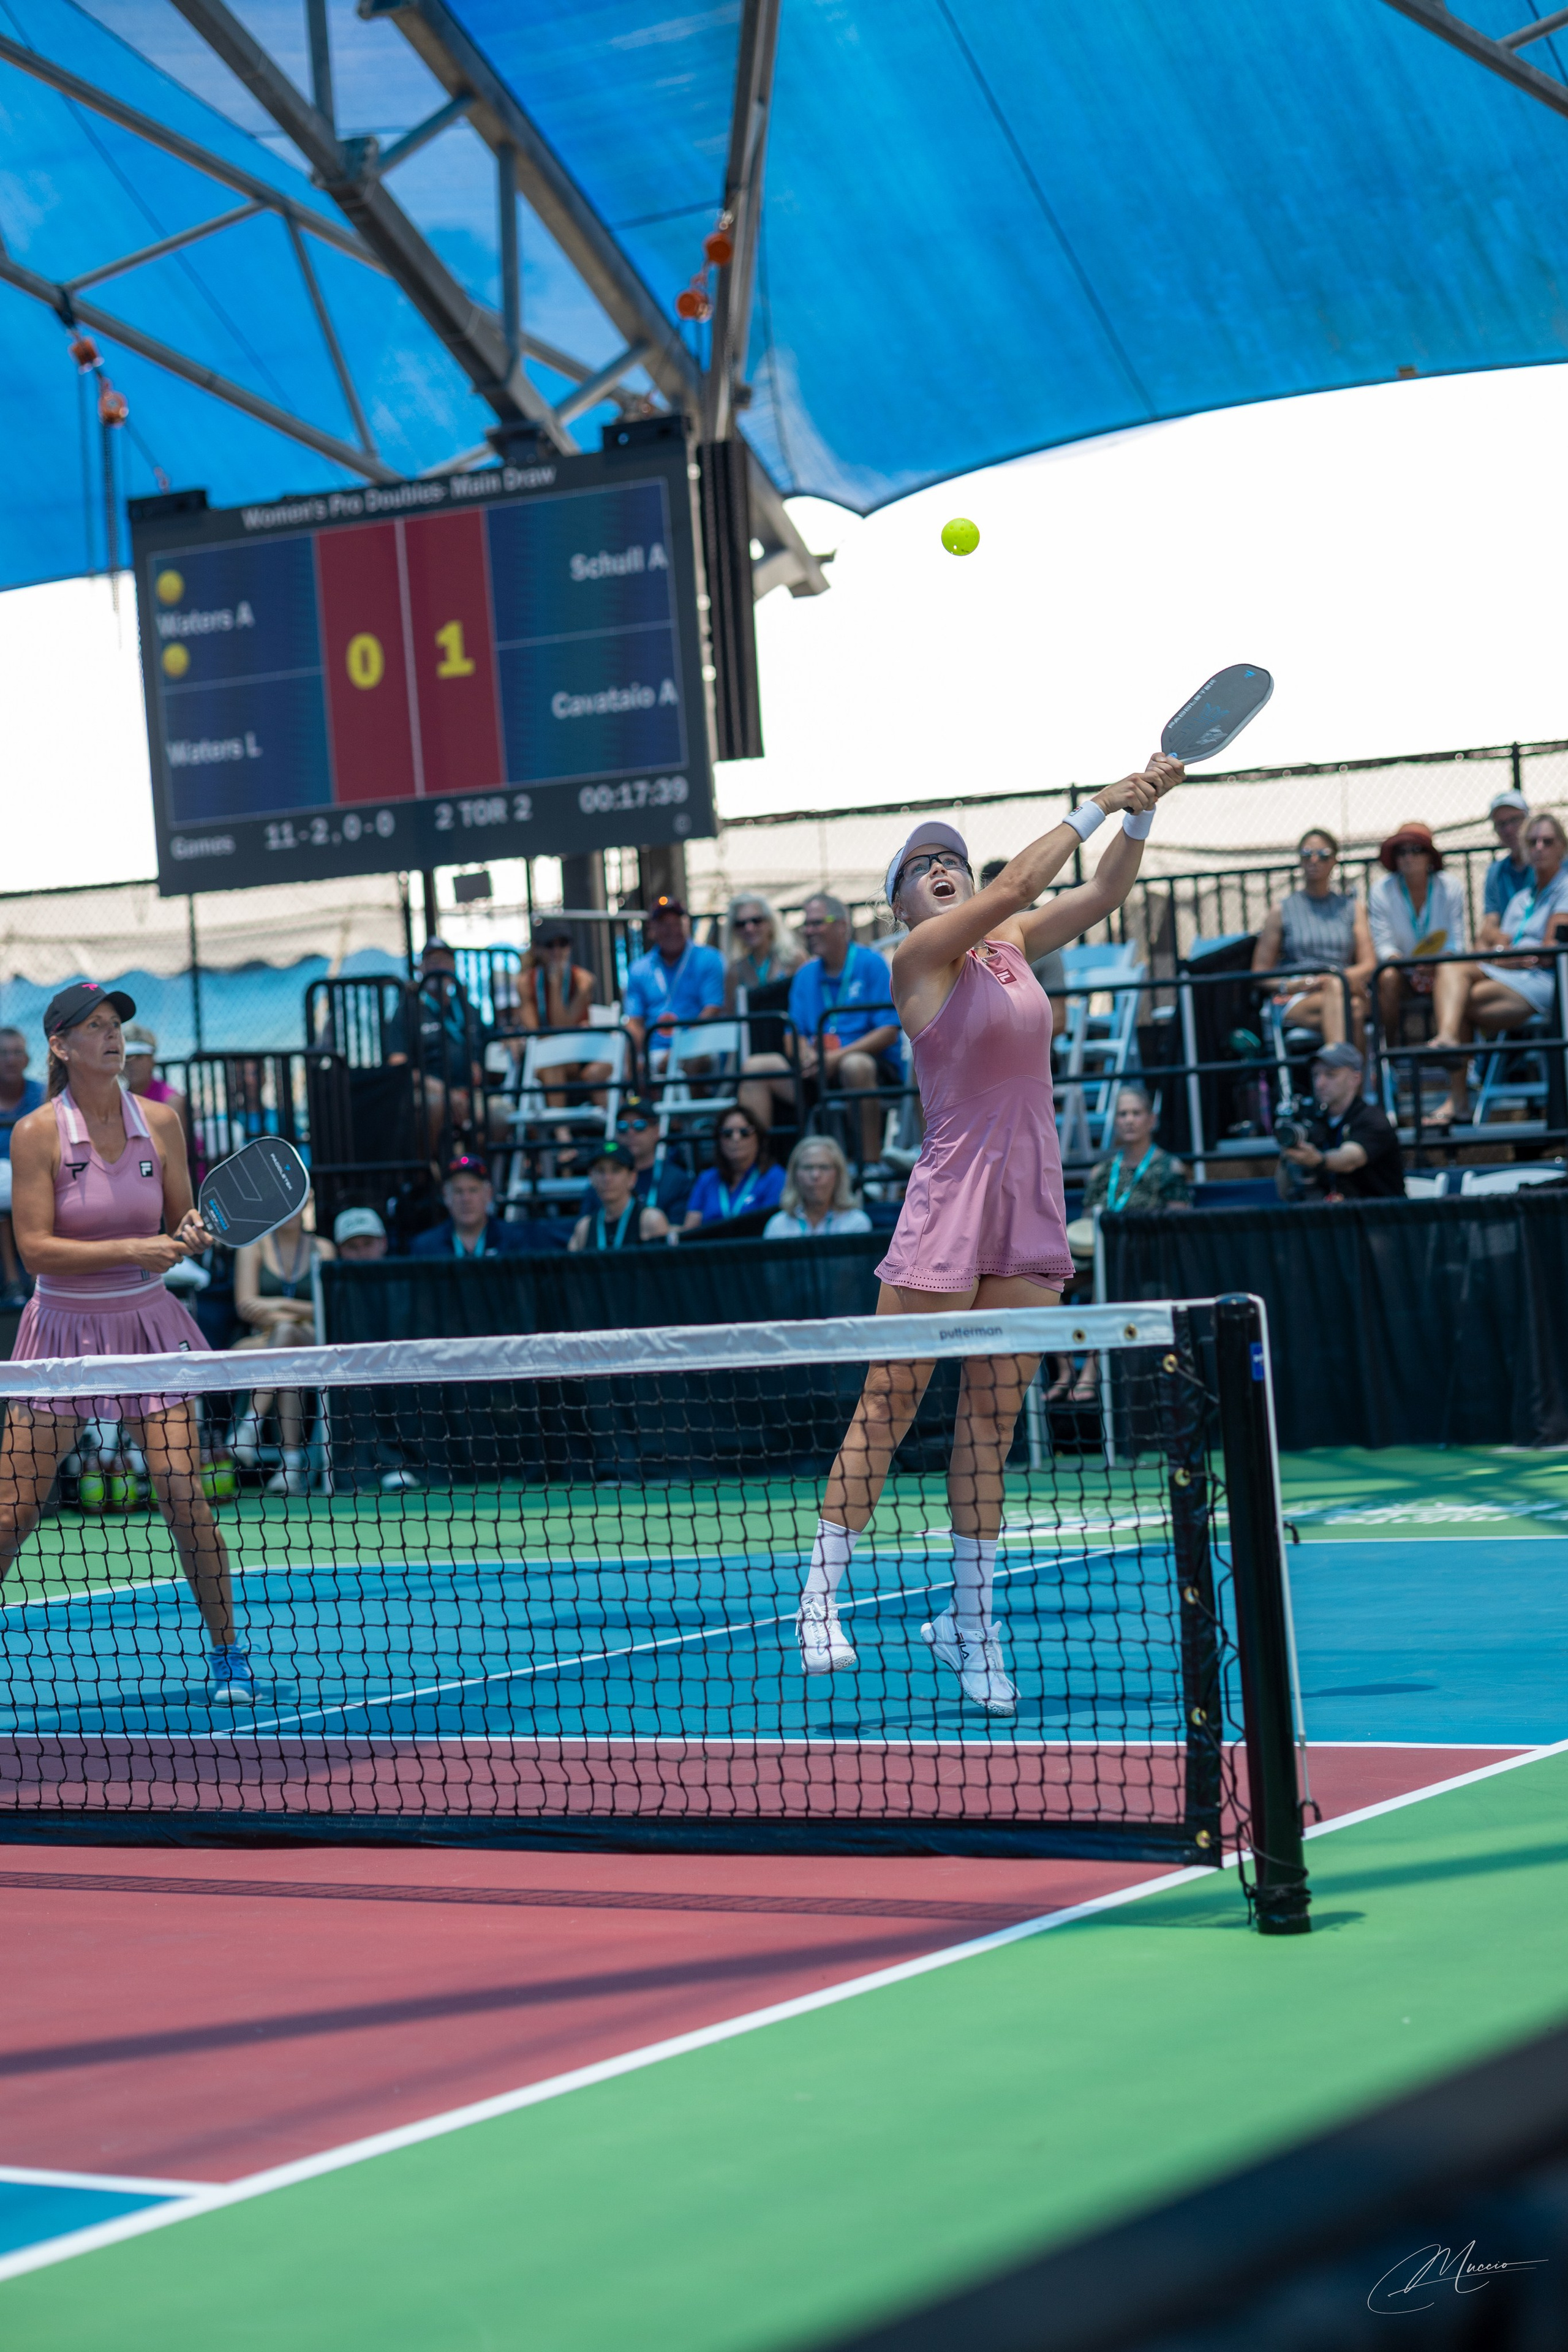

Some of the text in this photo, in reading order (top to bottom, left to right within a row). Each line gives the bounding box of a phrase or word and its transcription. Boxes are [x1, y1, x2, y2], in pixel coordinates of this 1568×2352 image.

[242, 497, 327, 530] Women's
[329, 493, 364, 518] Pro
[450, 472, 502, 499] Main
[503, 466, 556, 491] Draw
[648, 542, 669, 571] A
[156, 600, 255, 639] Waters A
[346, 631, 385, 690] 0
[435, 619, 476, 679] 1
[658, 678, 679, 706] A
[166, 731, 263, 767] Waters L
[435, 803, 454, 831] 2
[513, 794, 532, 821] 2
[579, 775, 689, 813] 00:17:39
[170, 835, 236, 860] Games
